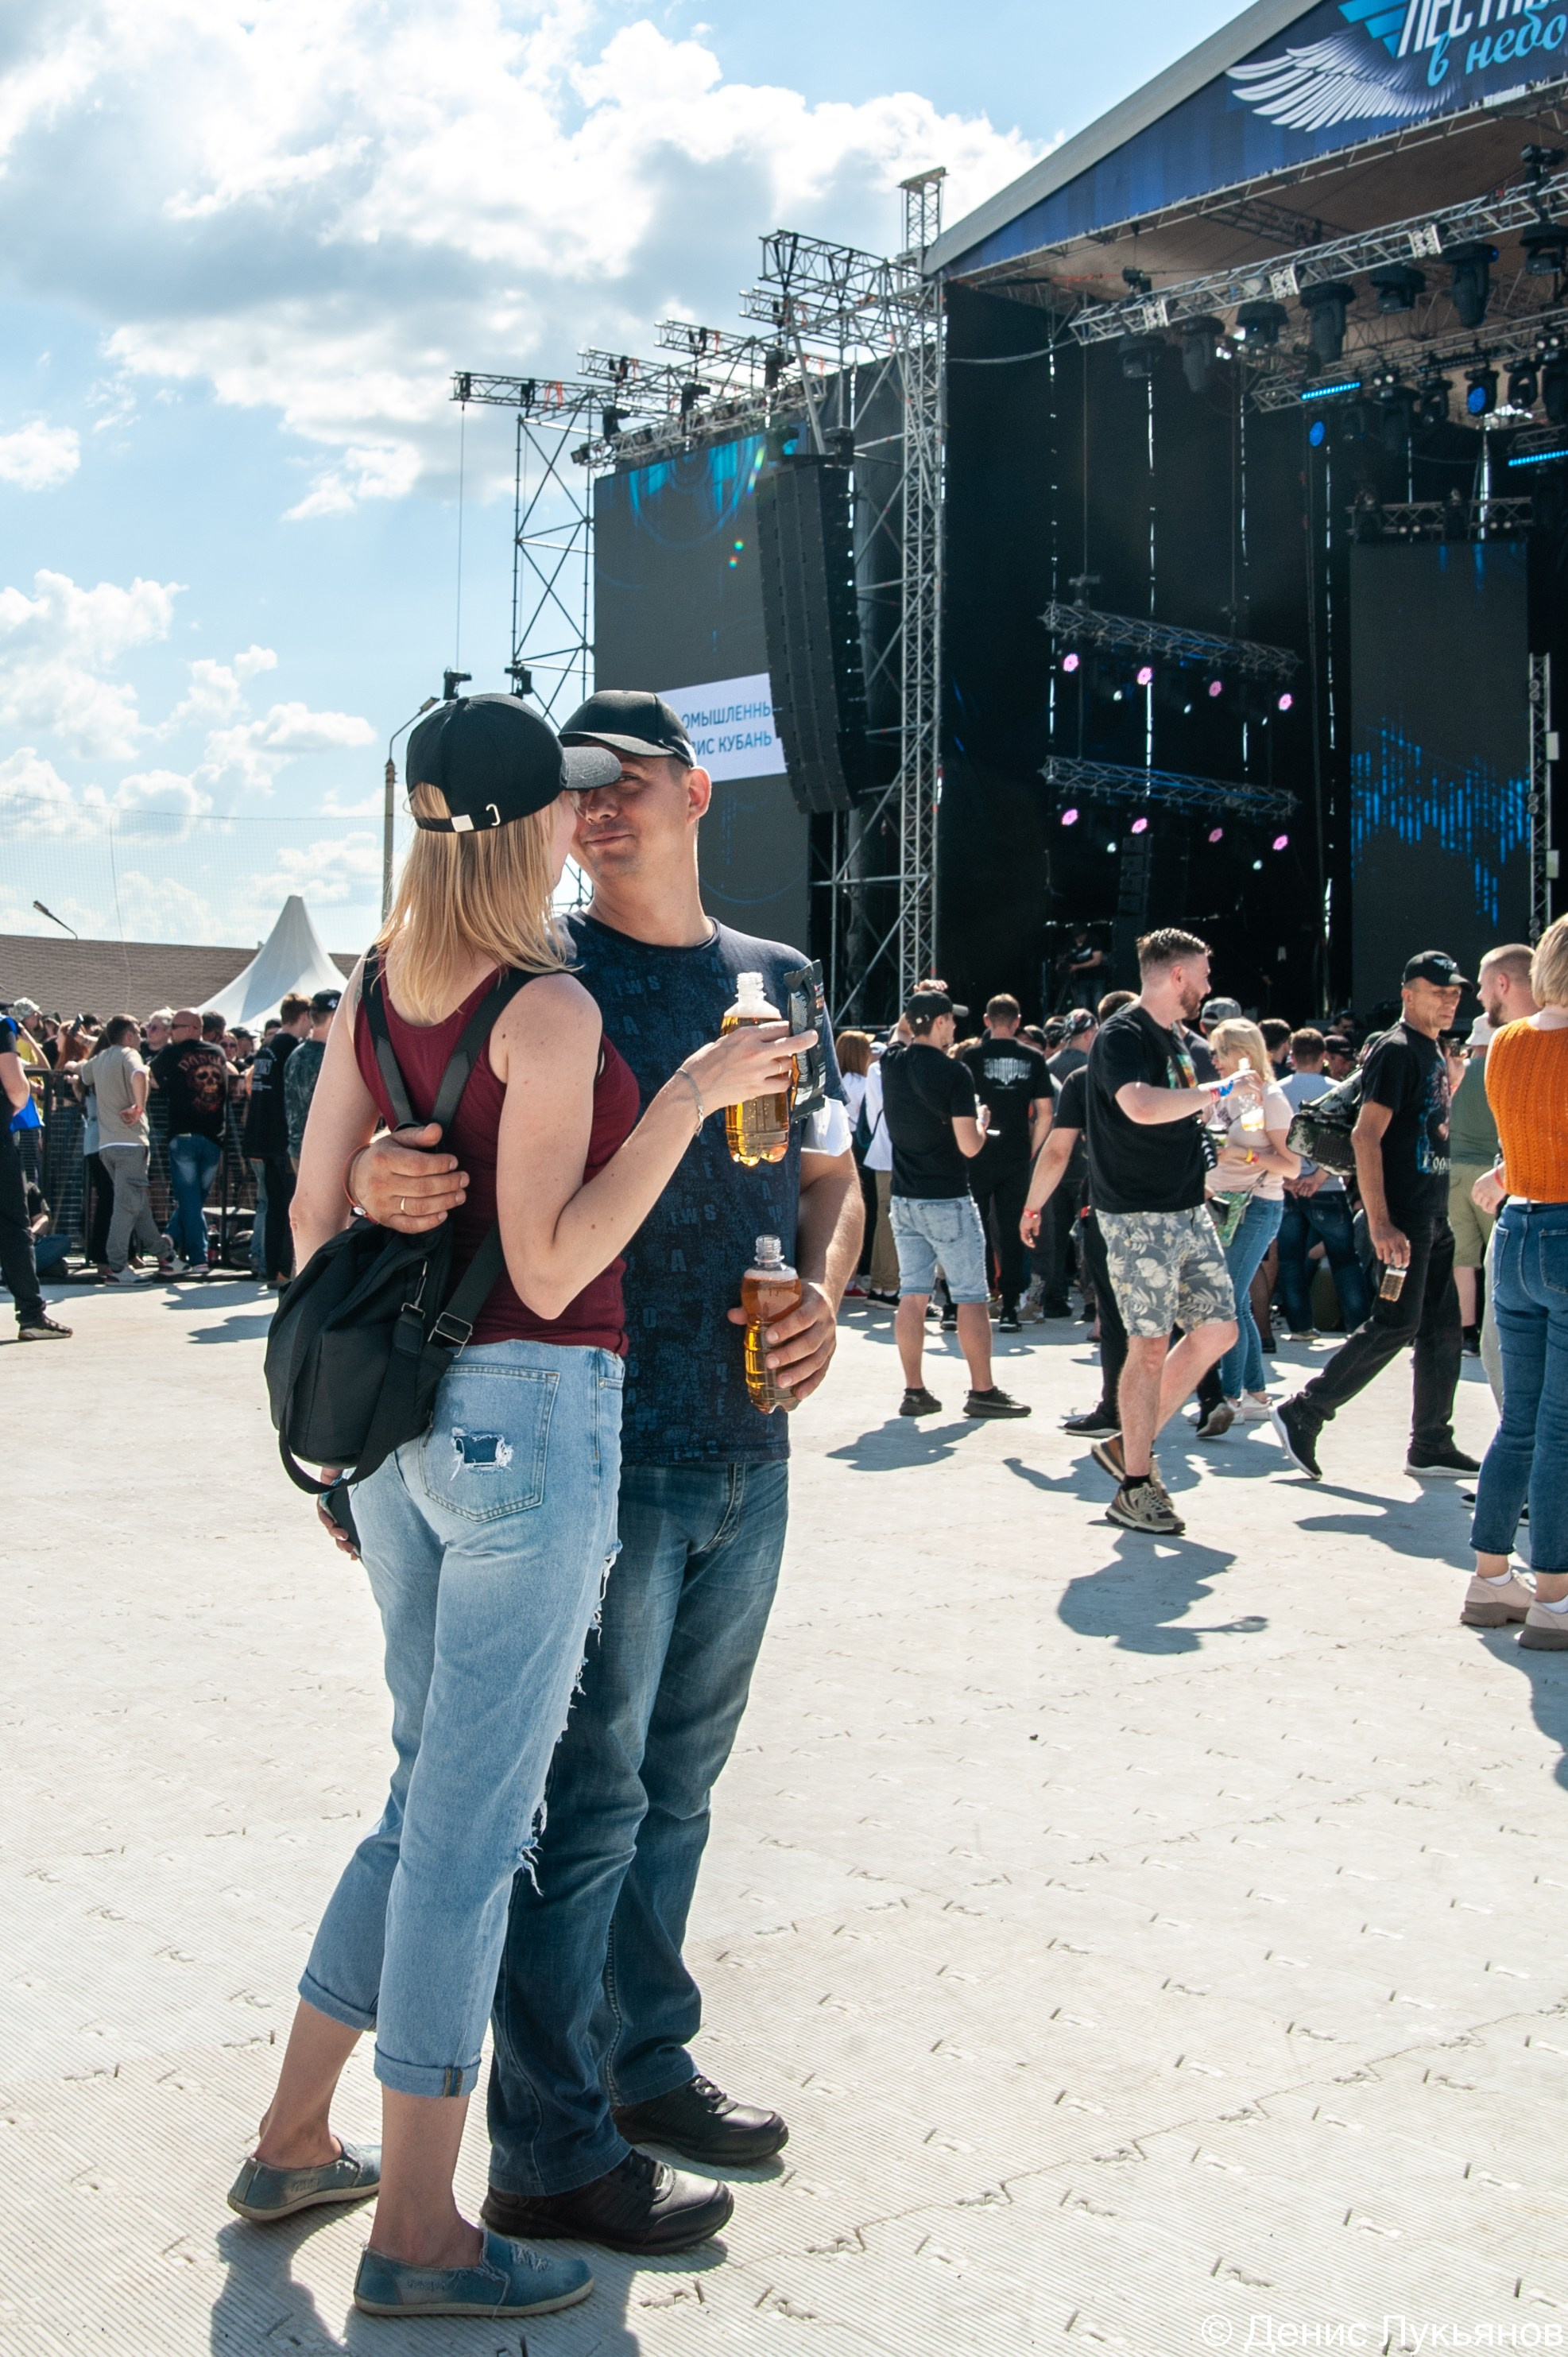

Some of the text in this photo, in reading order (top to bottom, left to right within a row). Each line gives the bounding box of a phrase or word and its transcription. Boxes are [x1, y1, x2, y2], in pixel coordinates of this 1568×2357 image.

[1427, 1, 1567, 87] в небо
[718, 731, 772, 753] КУБАНЬ
